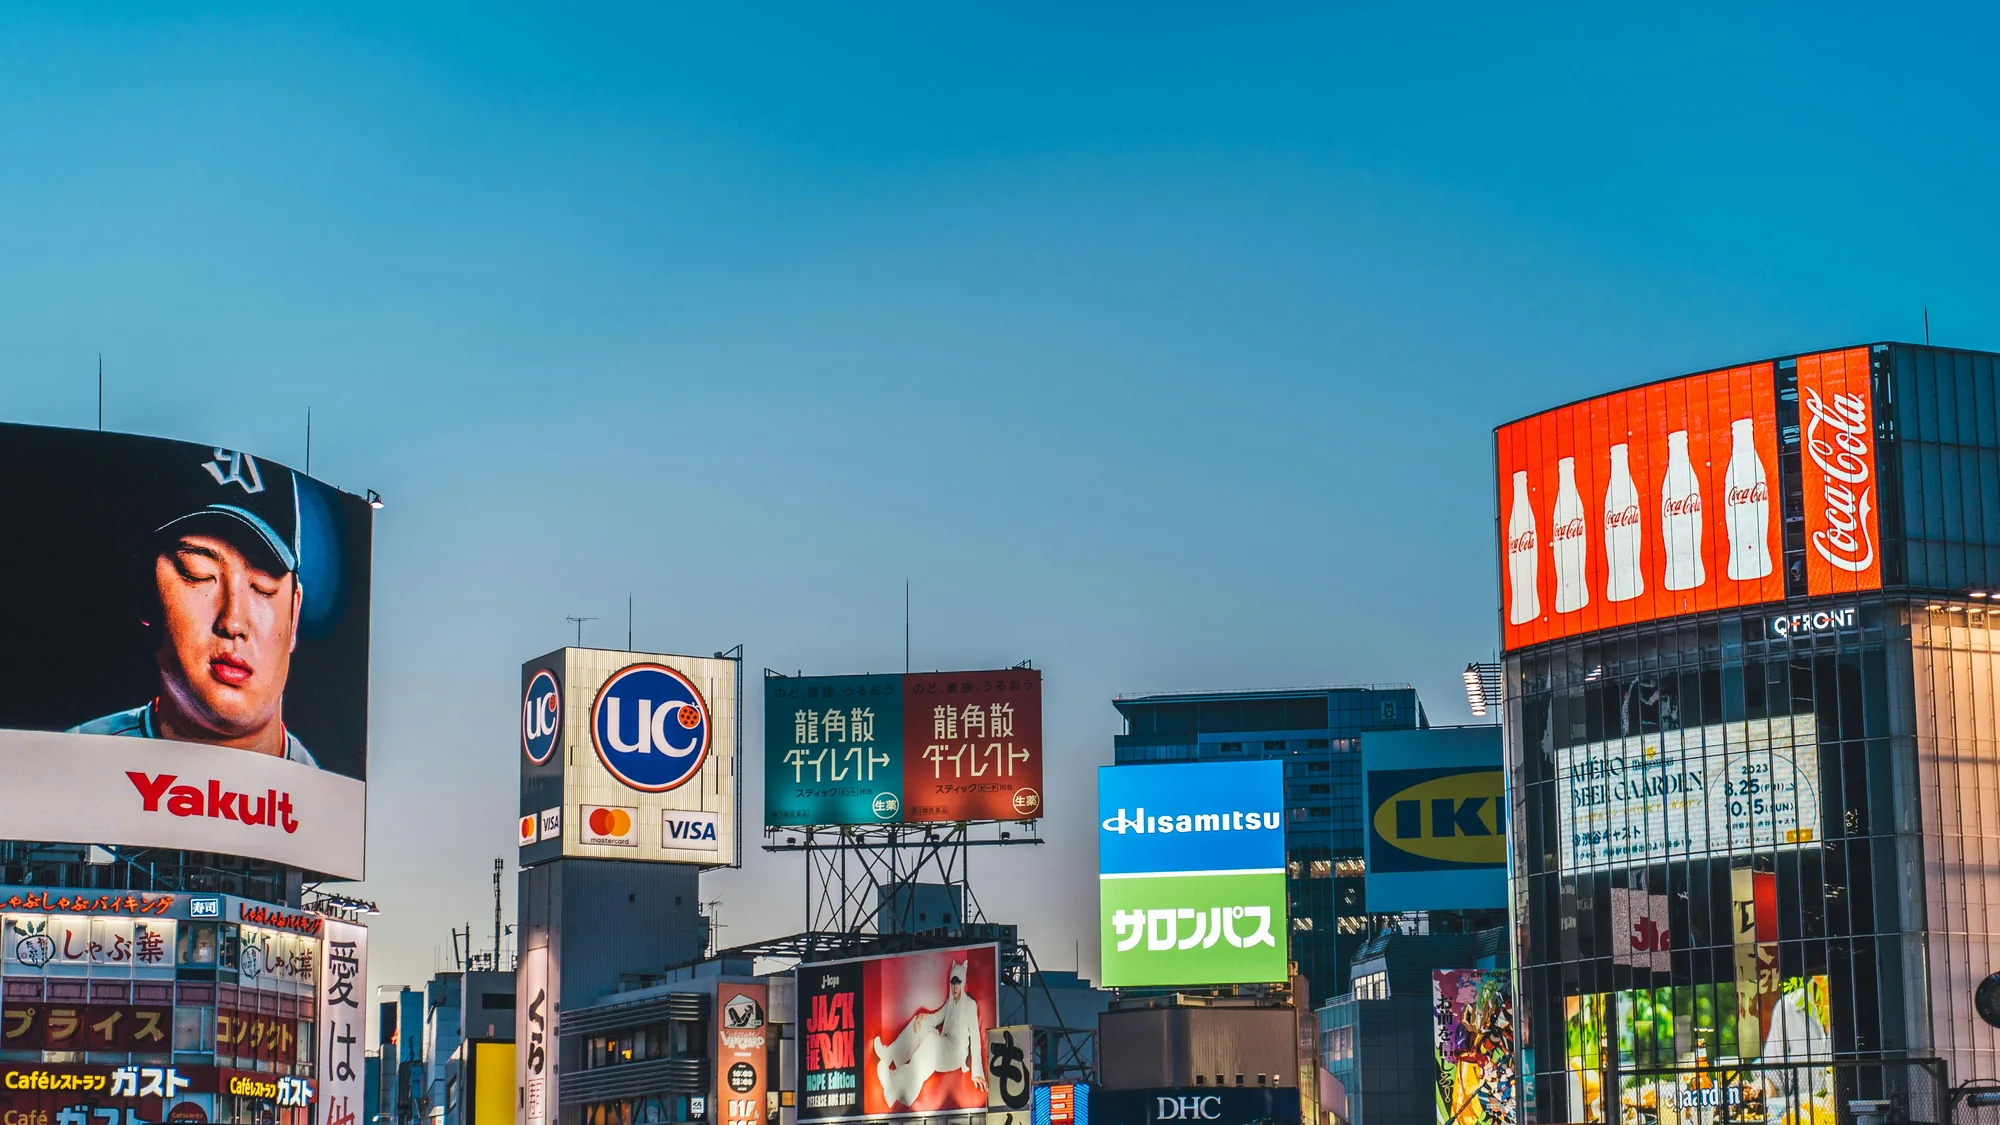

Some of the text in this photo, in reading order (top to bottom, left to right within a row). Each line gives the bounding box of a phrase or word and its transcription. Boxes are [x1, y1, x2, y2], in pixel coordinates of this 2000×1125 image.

[1805, 386, 1874, 571] Coca-Cola
[795, 707, 875, 744] 龍角散
[934, 703, 1014, 740] 龍角散
[783, 747, 890, 783] ダイレクト
[922, 743, 1031, 779] ダイレクト
[1742, 764, 1768, 775] 2023
[125, 771, 299, 834] Yakult
[874, 800, 896, 811] 生薬
[1015, 795, 1037, 807] 生薬
[543, 815, 559, 831] VISA
[664, 820, 717, 841] VISA
[1102, 807, 1280, 835] Hisamitsu
[590, 837, 630, 845] mastercard
[193, 901, 216, 915] 寿司
[240, 902, 323, 934] しゃぶしゃぶバイキング
[1112, 906, 1276, 952] サロンパス
[63, 929, 164, 964] しゃぶ葉
[265, 943, 313, 979] しゃぶ葉
[4, 1007, 165, 1042] プライス
[807, 992, 855, 1033] JACK
[216, 1015, 294, 1052] コンタクト
[110, 1065, 191, 1098] ガスト
[276, 1075, 314, 1107] ガスト
[1157, 1096, 1221, 1119] DHC
